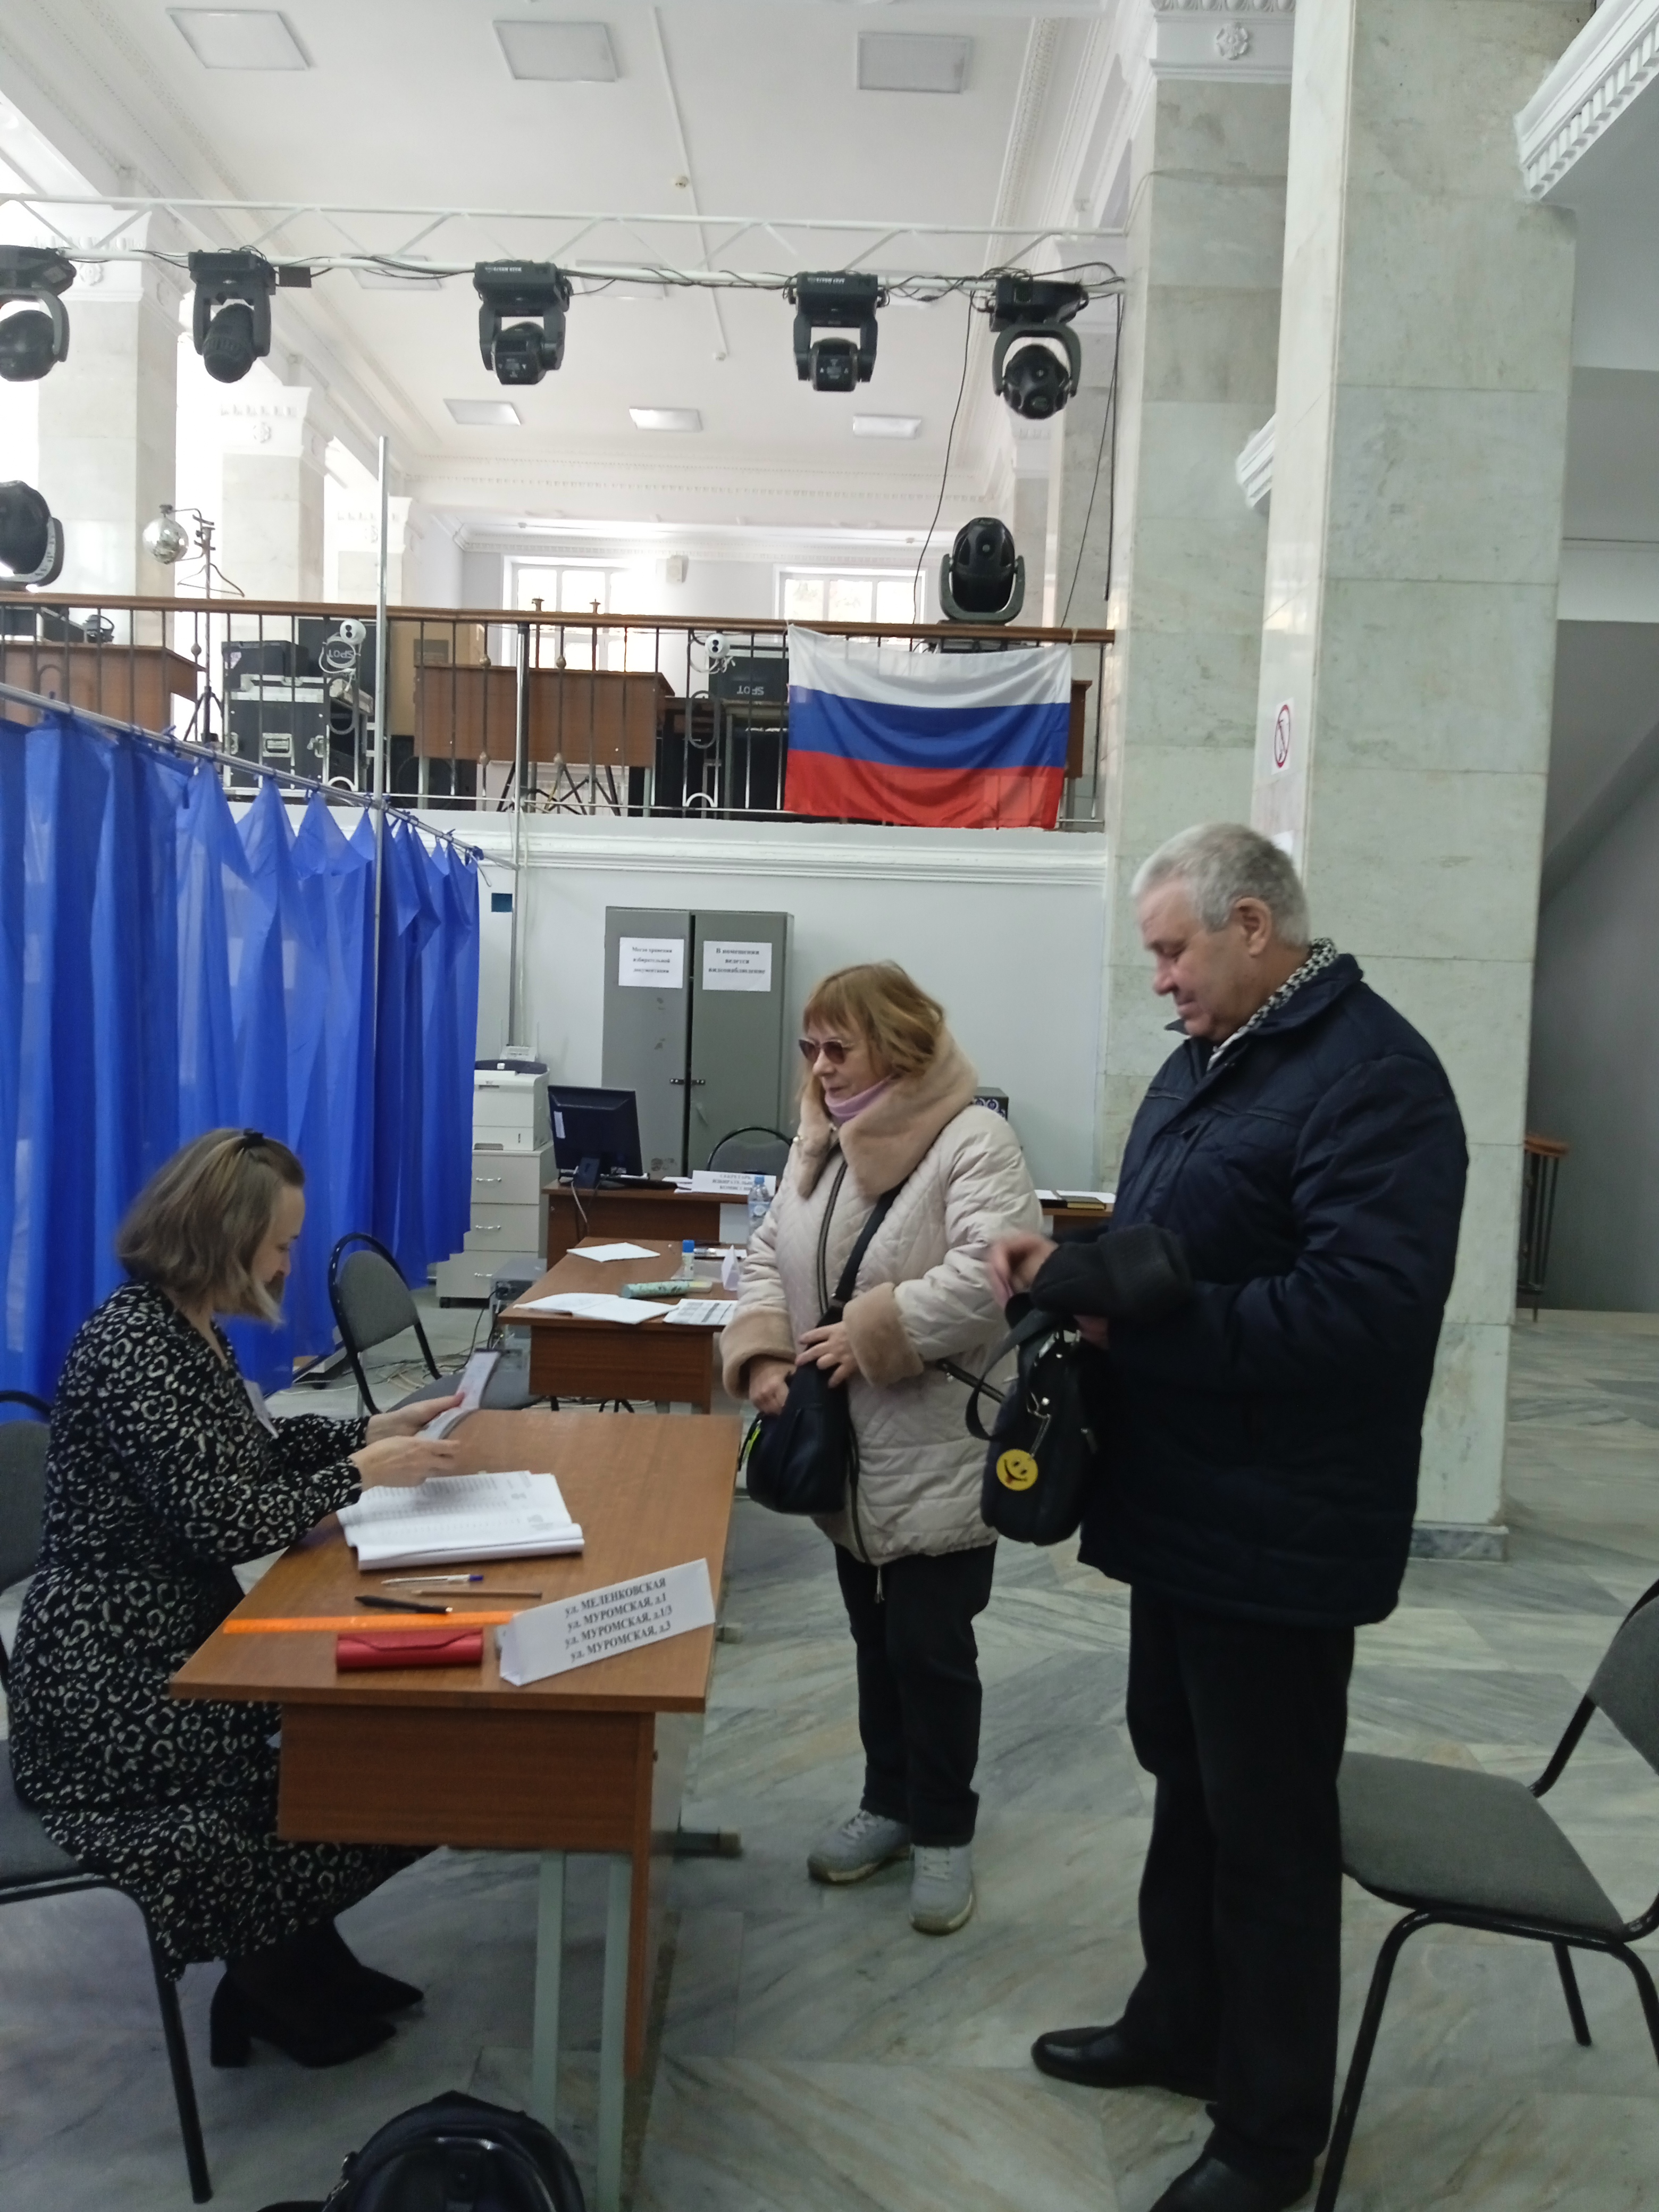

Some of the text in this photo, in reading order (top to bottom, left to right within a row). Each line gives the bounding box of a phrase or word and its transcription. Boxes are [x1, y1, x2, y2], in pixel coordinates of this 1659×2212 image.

[565, 1577, 666, 1619] ул. МЕЛЕНКОВСКАЯ
[567, 1620, 581, 1633] ул.
[584, 1597, 653, 1624] МУРОМСКАЯ,
[565, 1637, 579, 1650] ул.
[581, 1612, 652, 1640] МУРОМСКАЯ,
[571, 1650, 584, 1663] ул.
[588, 1626, 657, 1654] МУРОМСКАЯ,
